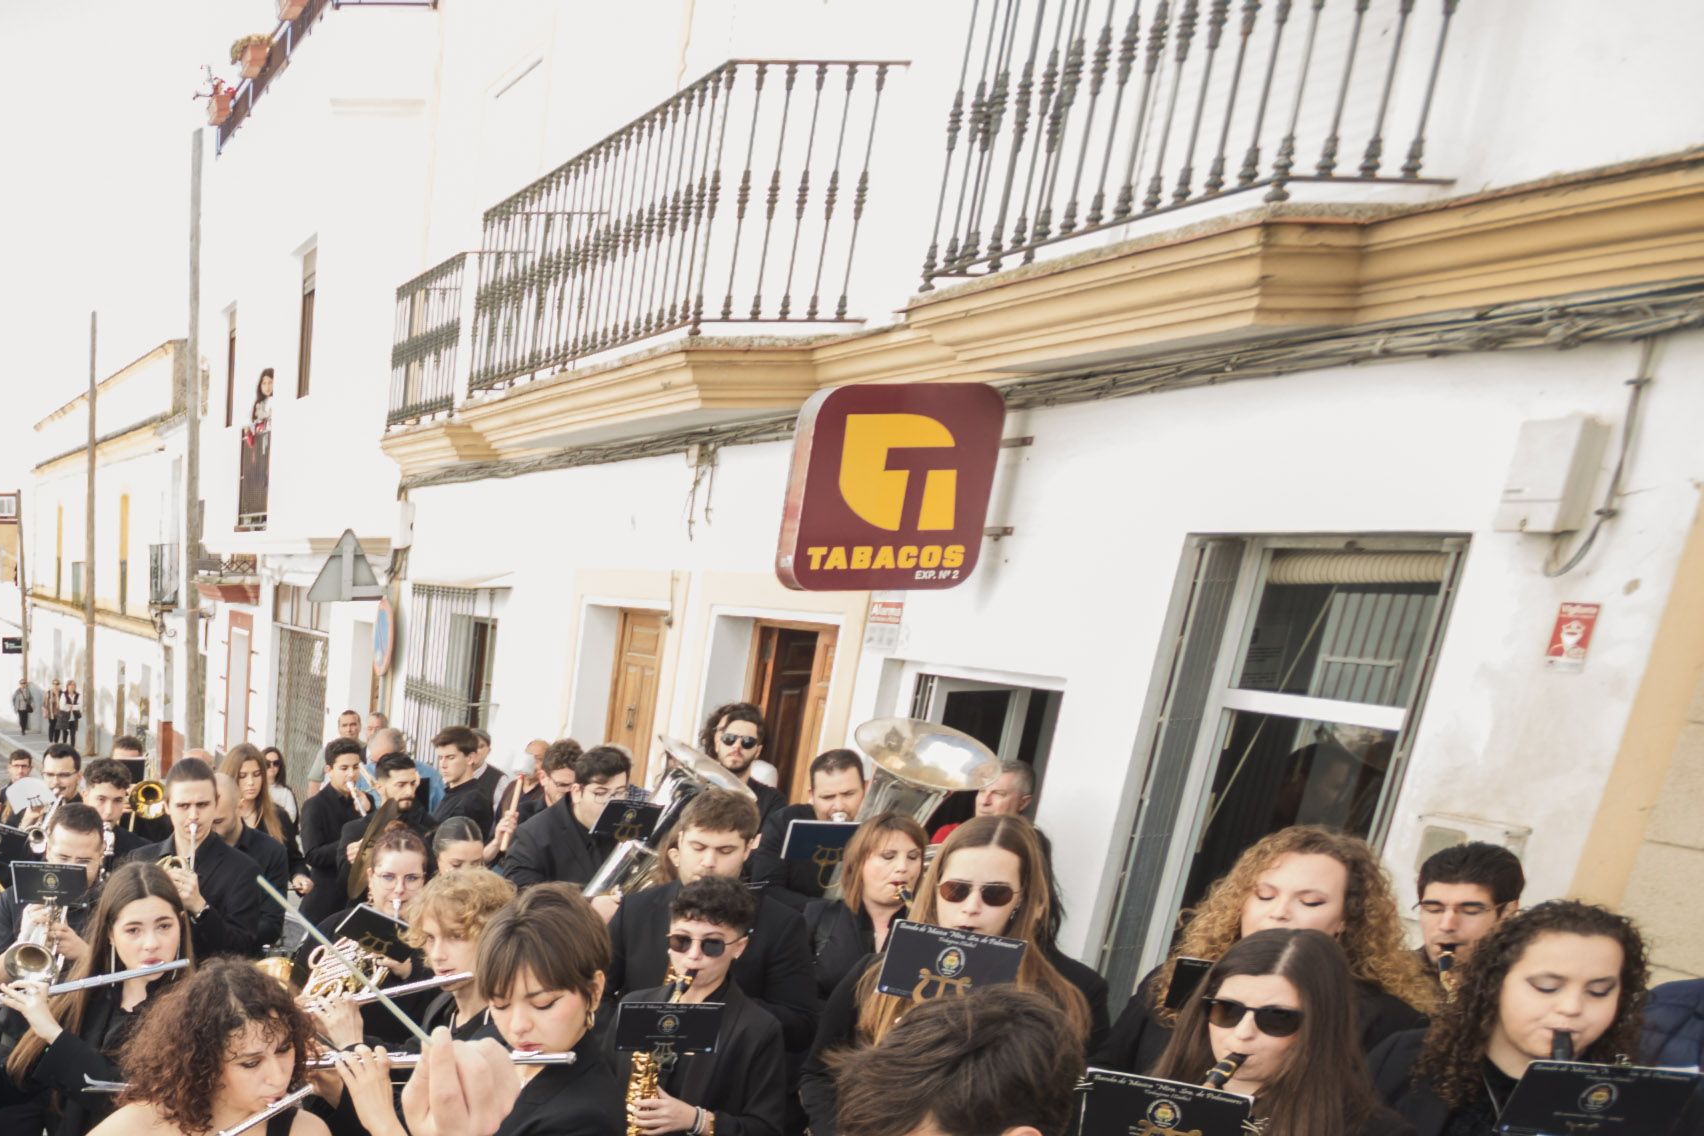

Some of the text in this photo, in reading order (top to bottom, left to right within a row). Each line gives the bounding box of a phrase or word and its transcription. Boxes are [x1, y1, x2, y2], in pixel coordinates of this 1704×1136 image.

[807, 545, 966, 570] TABACOS
[914, 570, 936, 579] EXP.
[952, 570, 960, 579] 2
